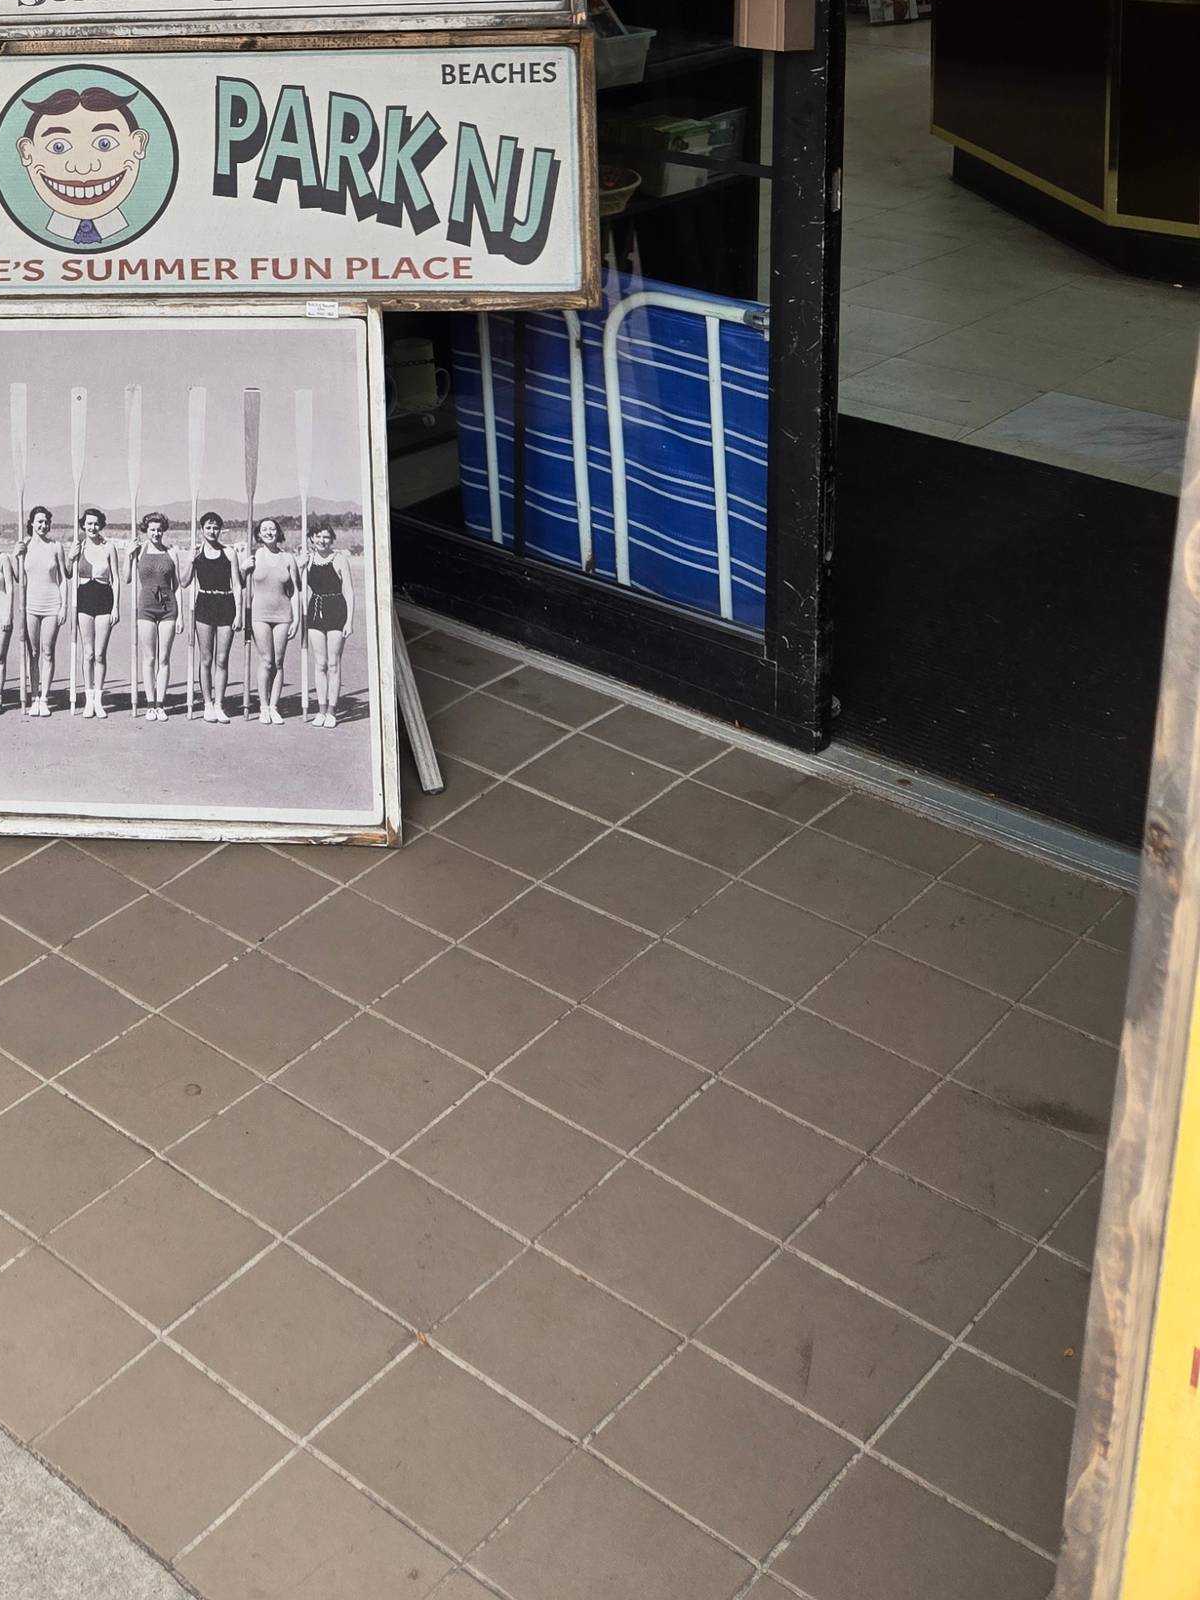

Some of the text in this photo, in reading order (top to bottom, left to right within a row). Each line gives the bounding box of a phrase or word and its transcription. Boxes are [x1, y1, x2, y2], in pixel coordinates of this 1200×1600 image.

[441, 61, 557, 85] BEACHES
[213, 75, 448, 236] PARK
[446, 121, 561, 266] NJ
[61, 256, 240, 282] SUMMER
[251, 256, 333, 280] FUN
[345, 255, 473, 280] PLACE
